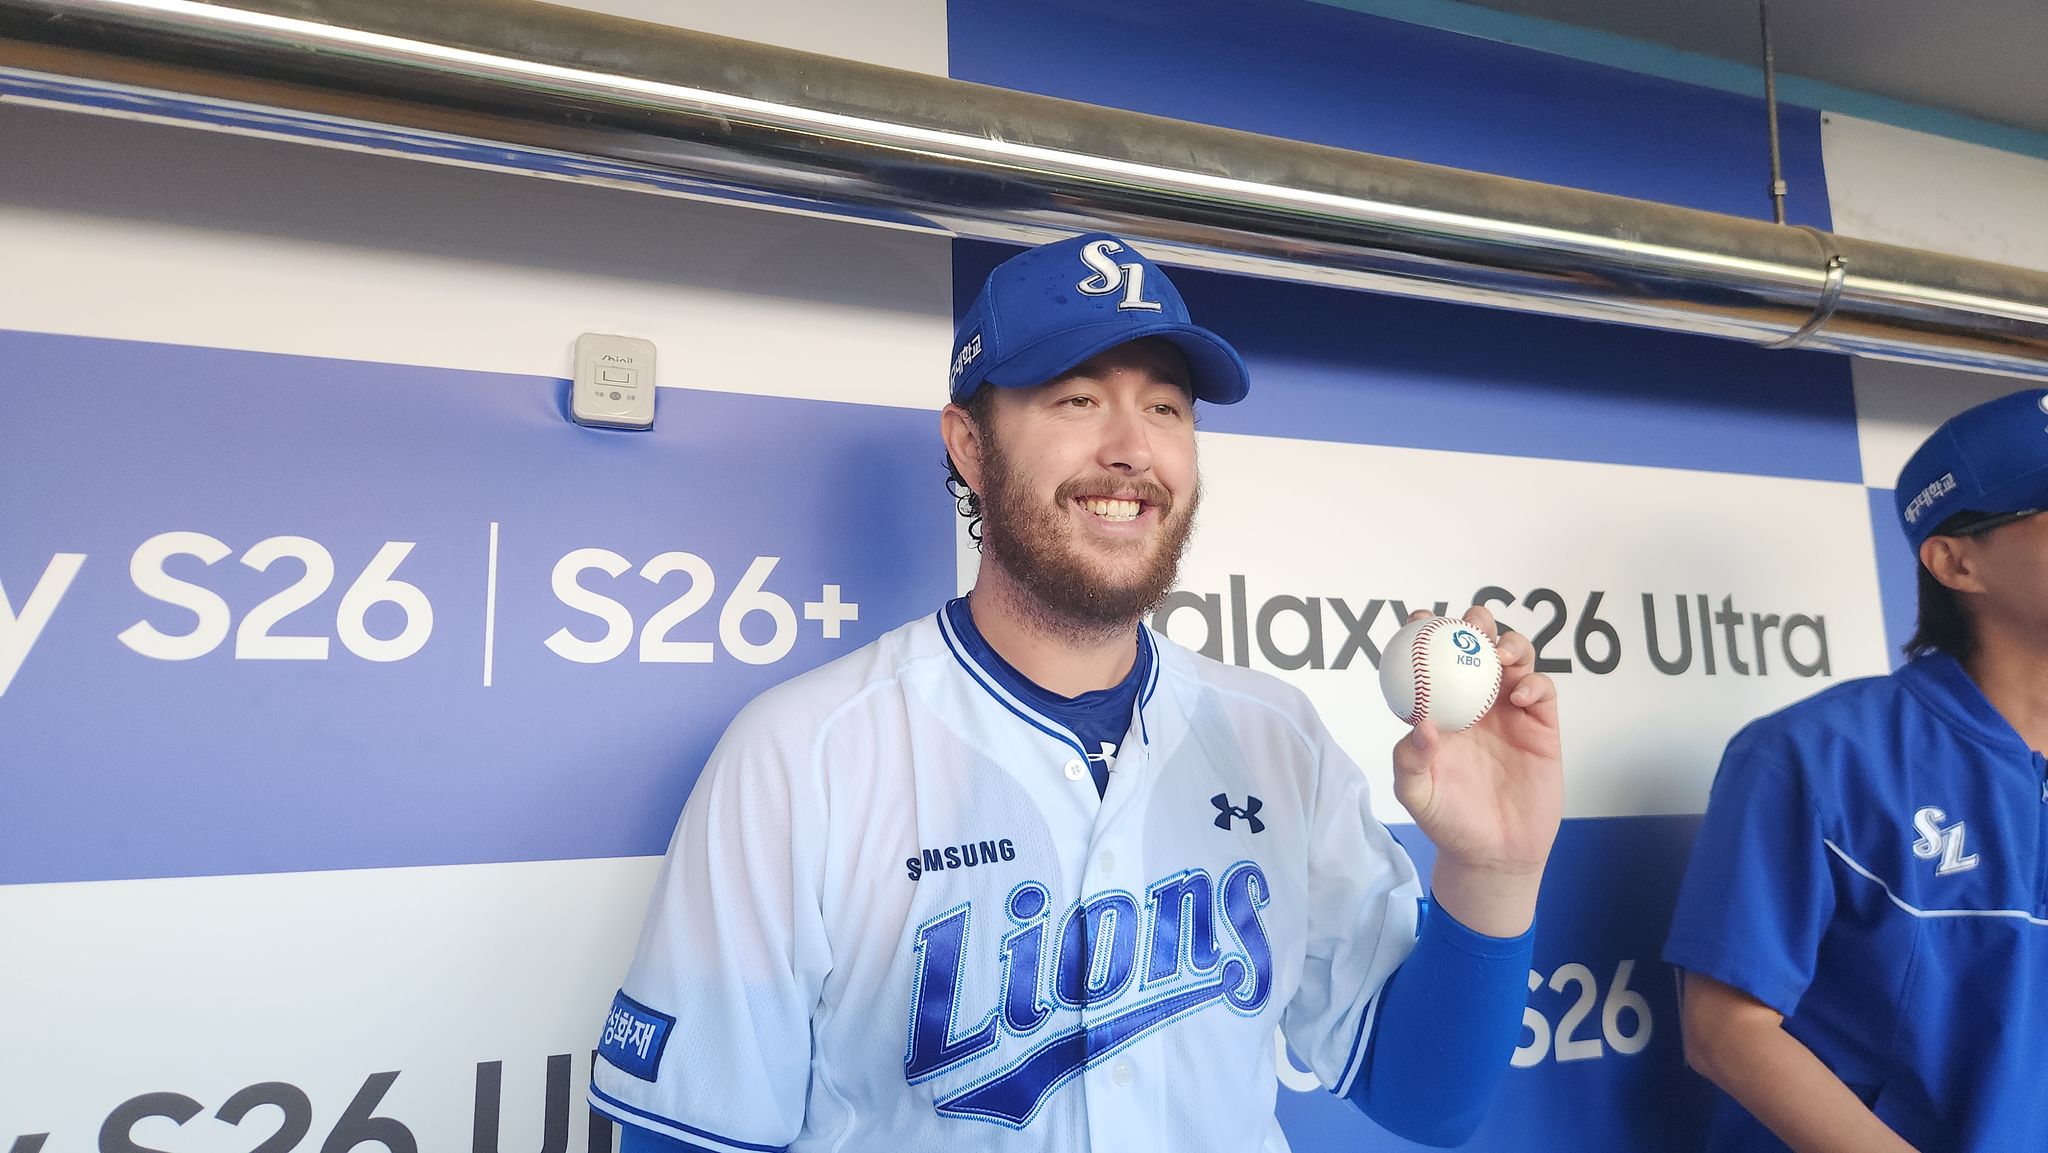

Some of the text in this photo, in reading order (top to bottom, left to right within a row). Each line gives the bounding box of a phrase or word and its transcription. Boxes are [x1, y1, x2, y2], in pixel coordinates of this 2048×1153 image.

[116, 531, 434, 662] S26
[543, 547, 859, 665] S26+
[1641, 592, 1832, 677] Ultra
[1456, 654, 1482, 667] KBO
[904, 860, 1272, 1087] Lions
[604, 1004, 657, 1060] 성화재
